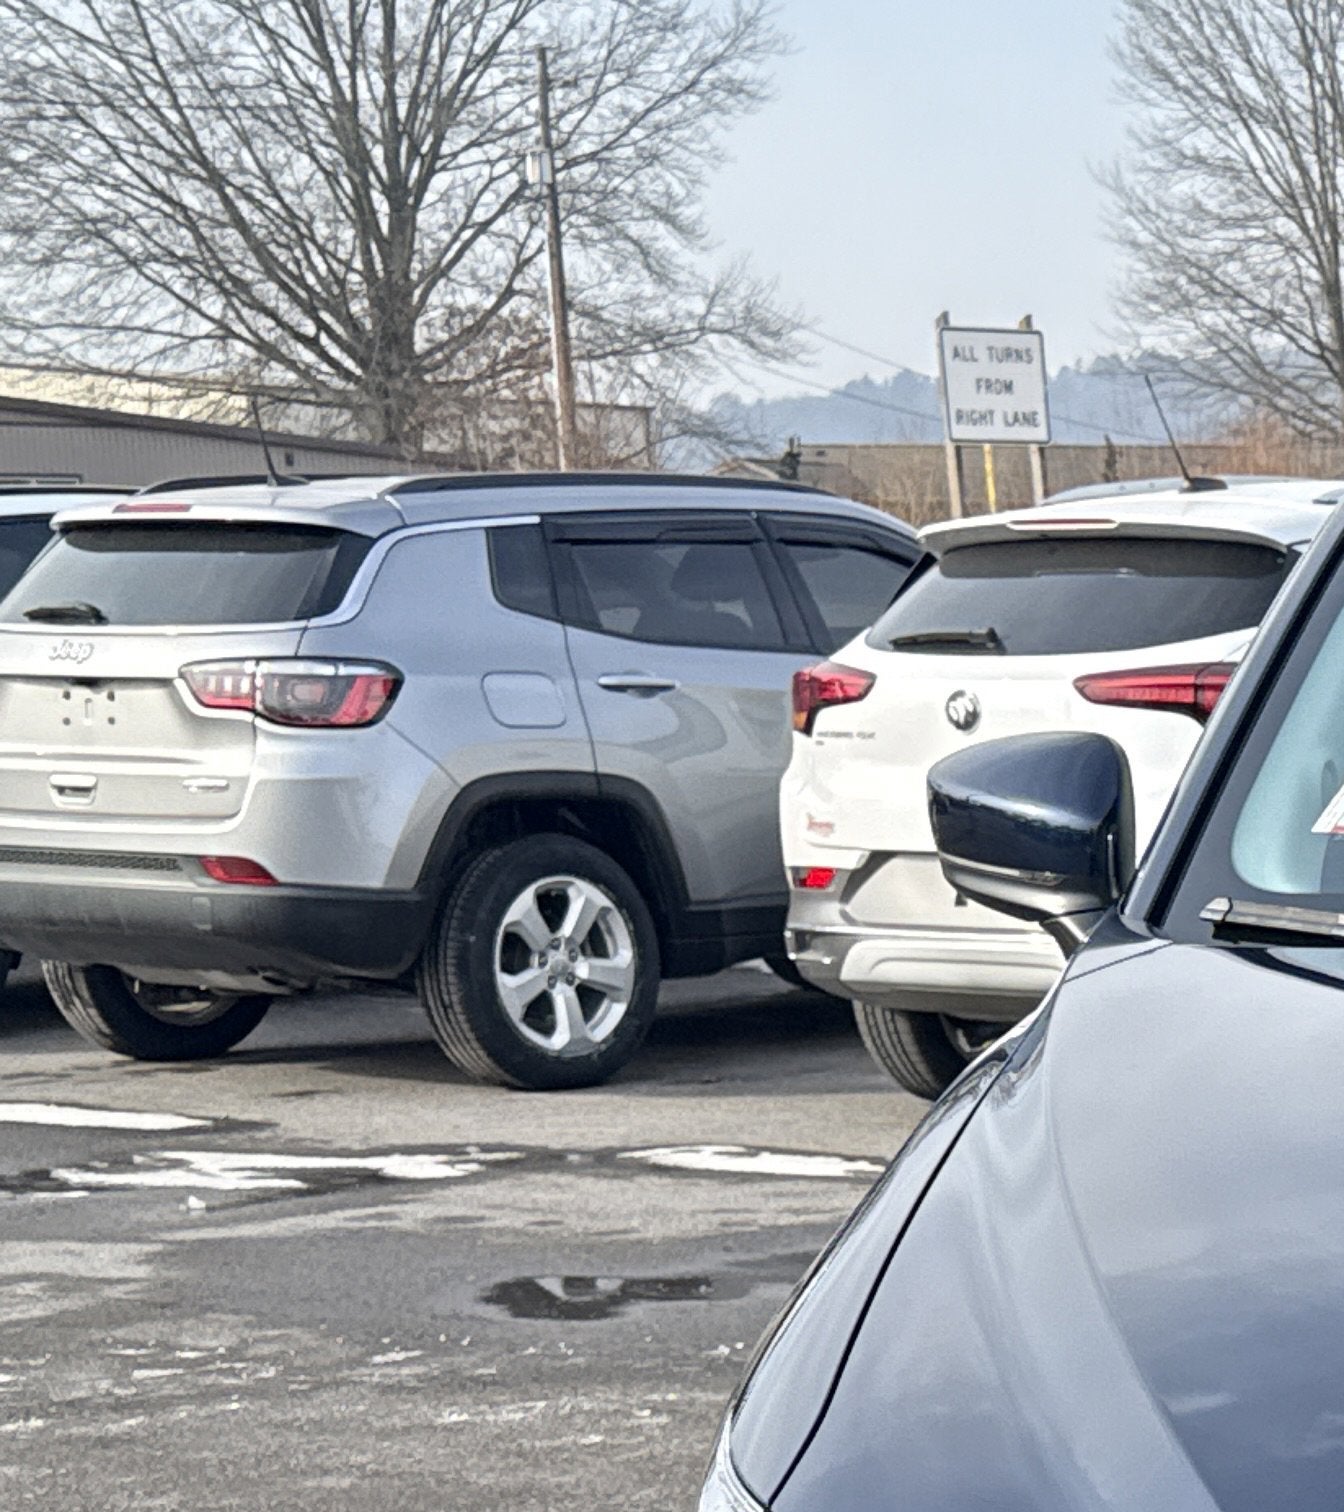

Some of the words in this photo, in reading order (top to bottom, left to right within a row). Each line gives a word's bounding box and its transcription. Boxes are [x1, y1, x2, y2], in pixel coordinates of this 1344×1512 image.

[952, 344, 979, 364] ALL
[986, 346, 1034, 365] TURNS
[975, 378, 1014, 396] FROM
[955, 409, 995, 427] RIGHT
[1003, 411, 1040, 429] LANE
[48, 638, 95, 665] Jeep
